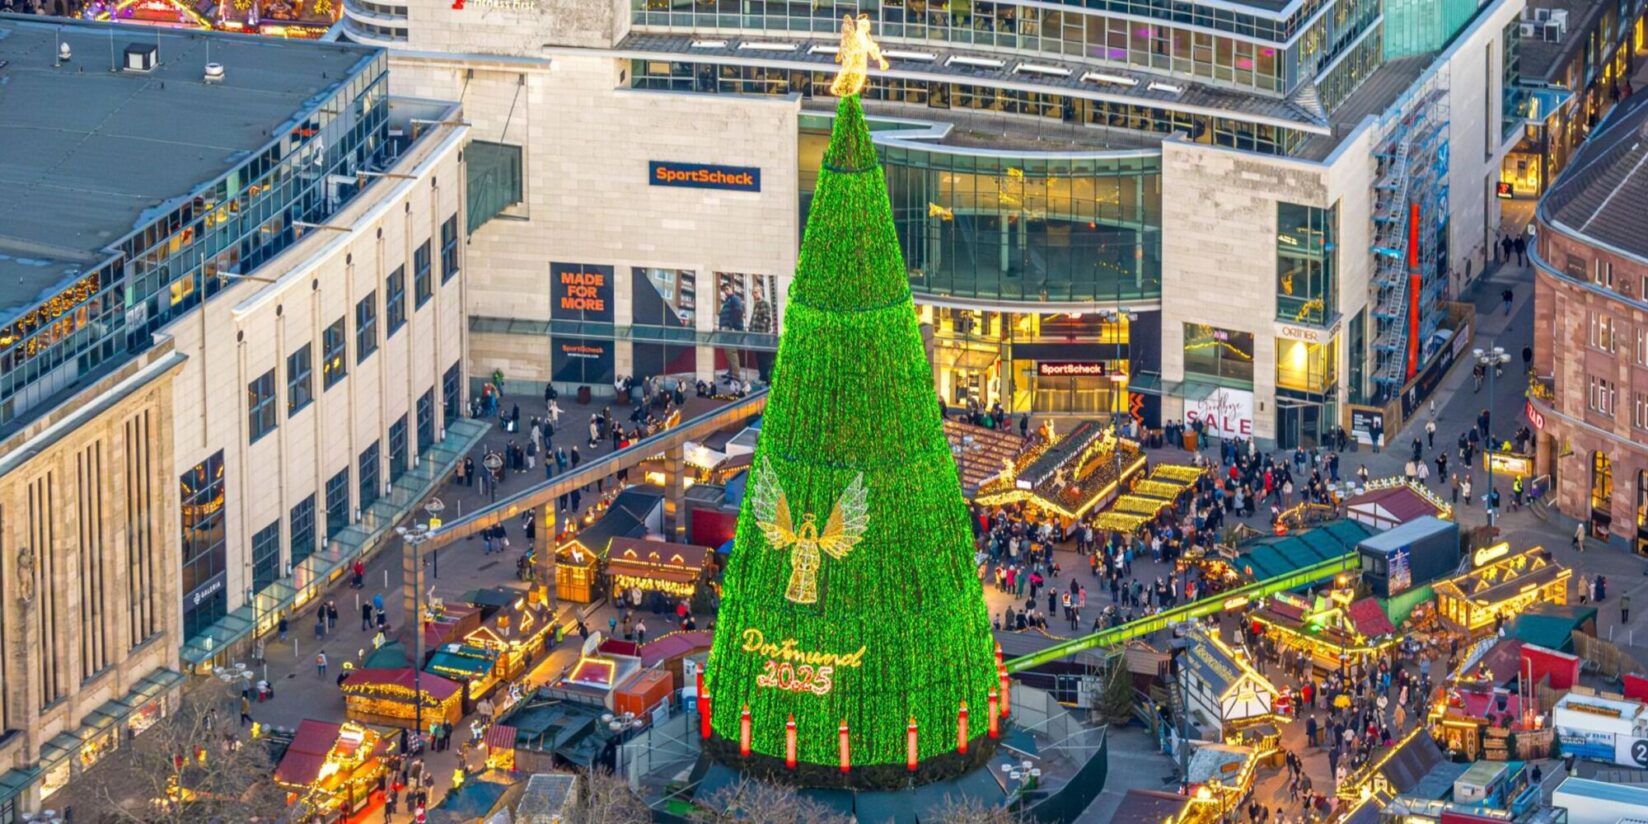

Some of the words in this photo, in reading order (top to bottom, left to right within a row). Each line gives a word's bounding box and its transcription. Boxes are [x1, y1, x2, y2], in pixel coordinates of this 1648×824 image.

[656, 167, 753, 185] SportScheck
[561, 272, 604, 286] MADE
[568, 285, 597, 298] FOR
[561, 297, 604, 311] MORE
[1041, 364, 1101, 375] SportScheck
[1186, 411, 1252, 436] SALE
[742, 628, 867, 667] Dortmund
[757, 660, 834, 695] 2025
